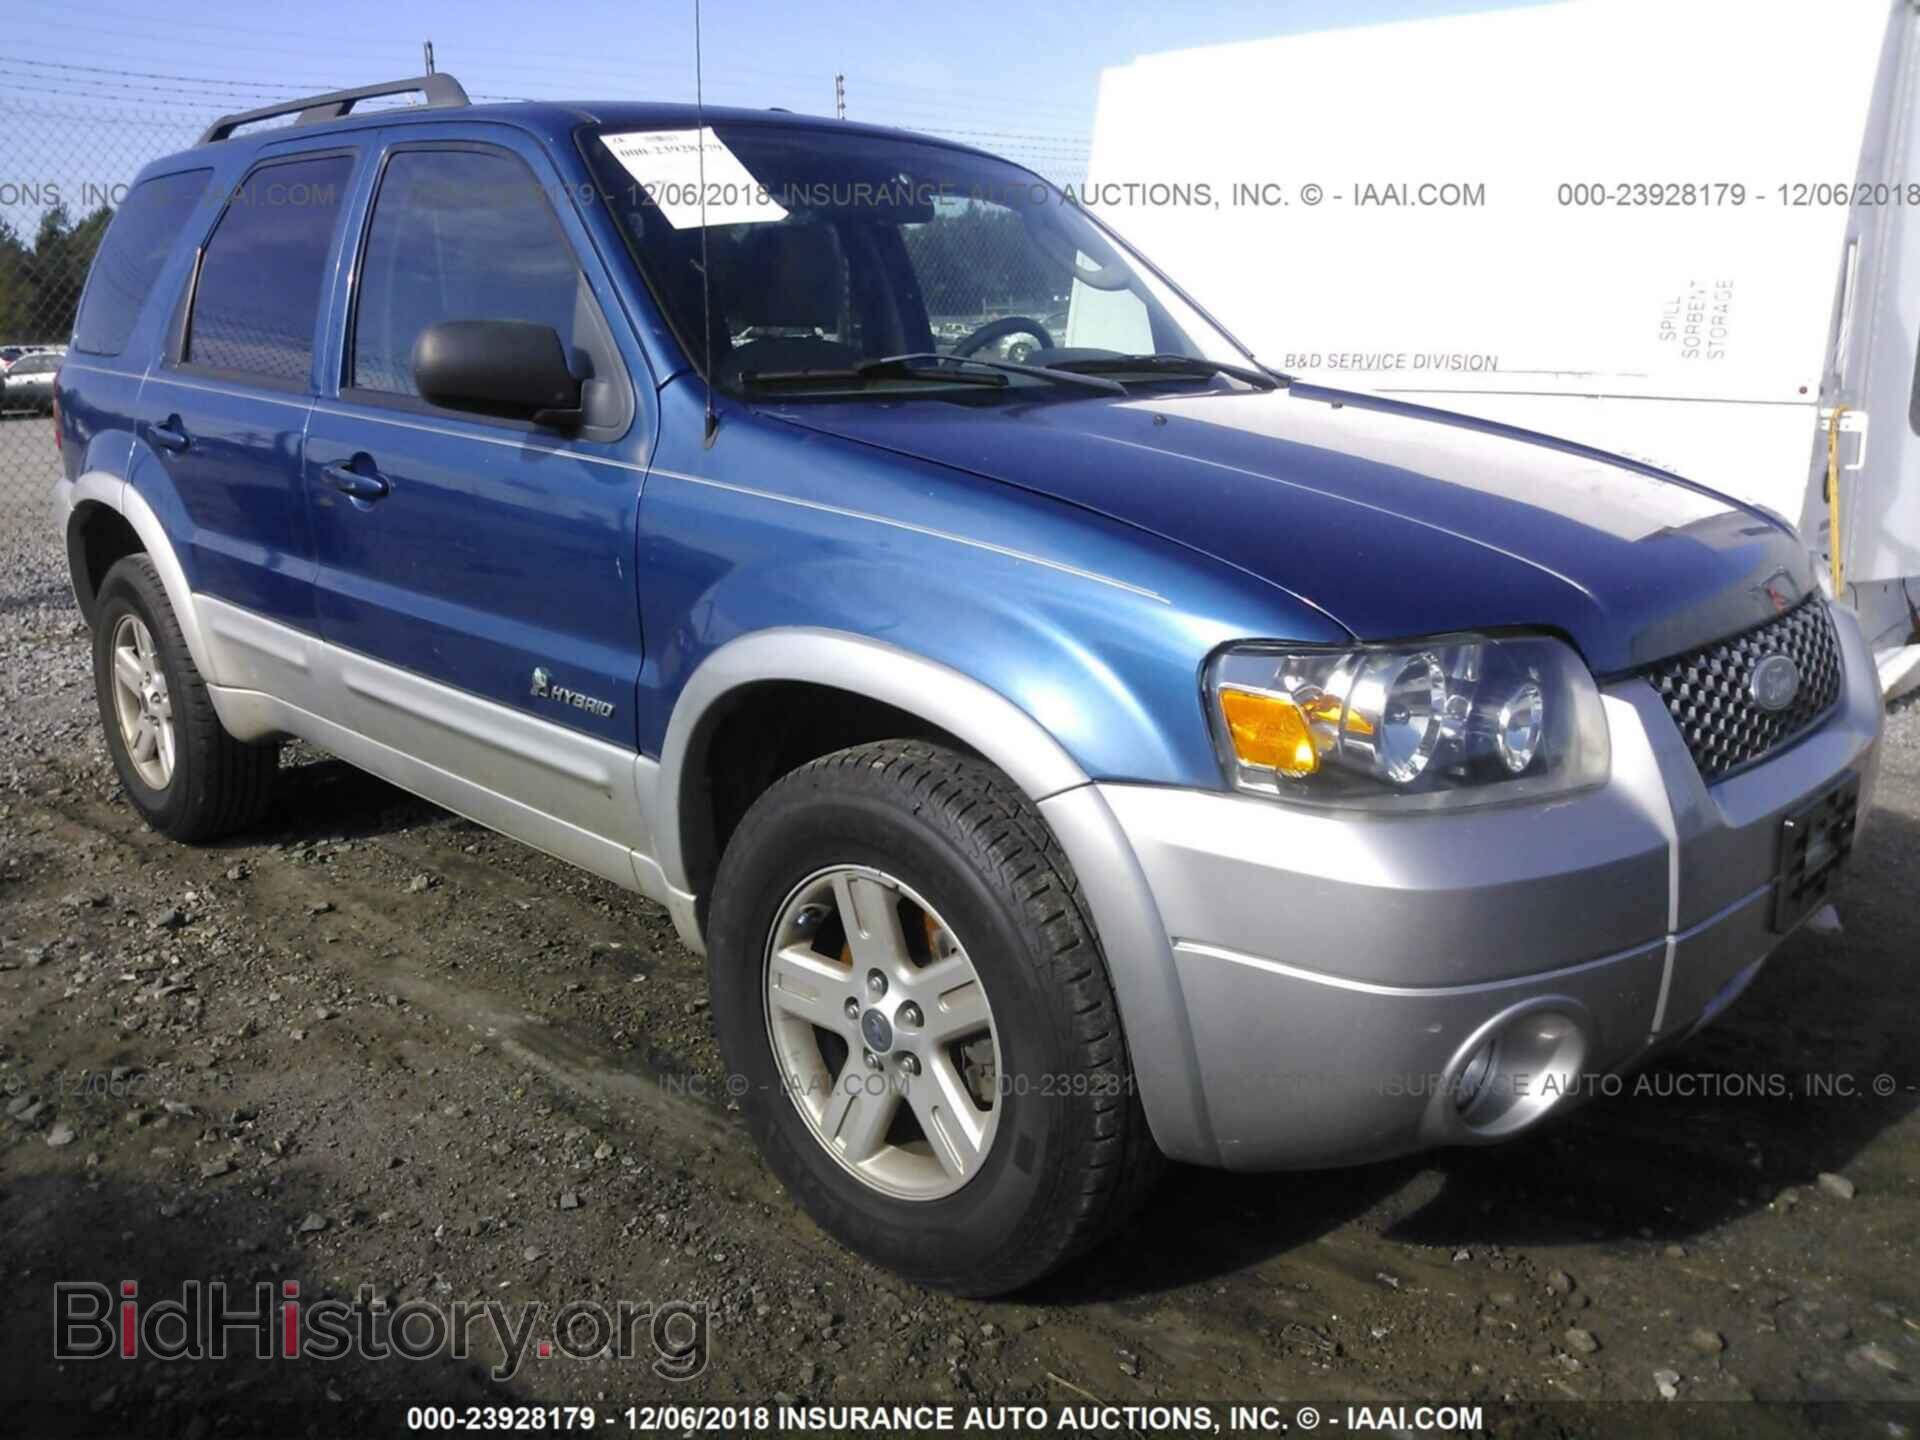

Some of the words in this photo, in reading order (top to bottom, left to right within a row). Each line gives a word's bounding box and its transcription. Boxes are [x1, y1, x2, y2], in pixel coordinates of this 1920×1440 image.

[1658, 296, 1681, 341] SPILL
[1706, 279, 1734, 360] STORAGE
[1285, 353, 1322, 369] B&D
[1327, 353, 1406, 370] SERVICE
[1413, 353, 1498, 371] DIVISION
[551, 686, 615, 717] HYBRID
